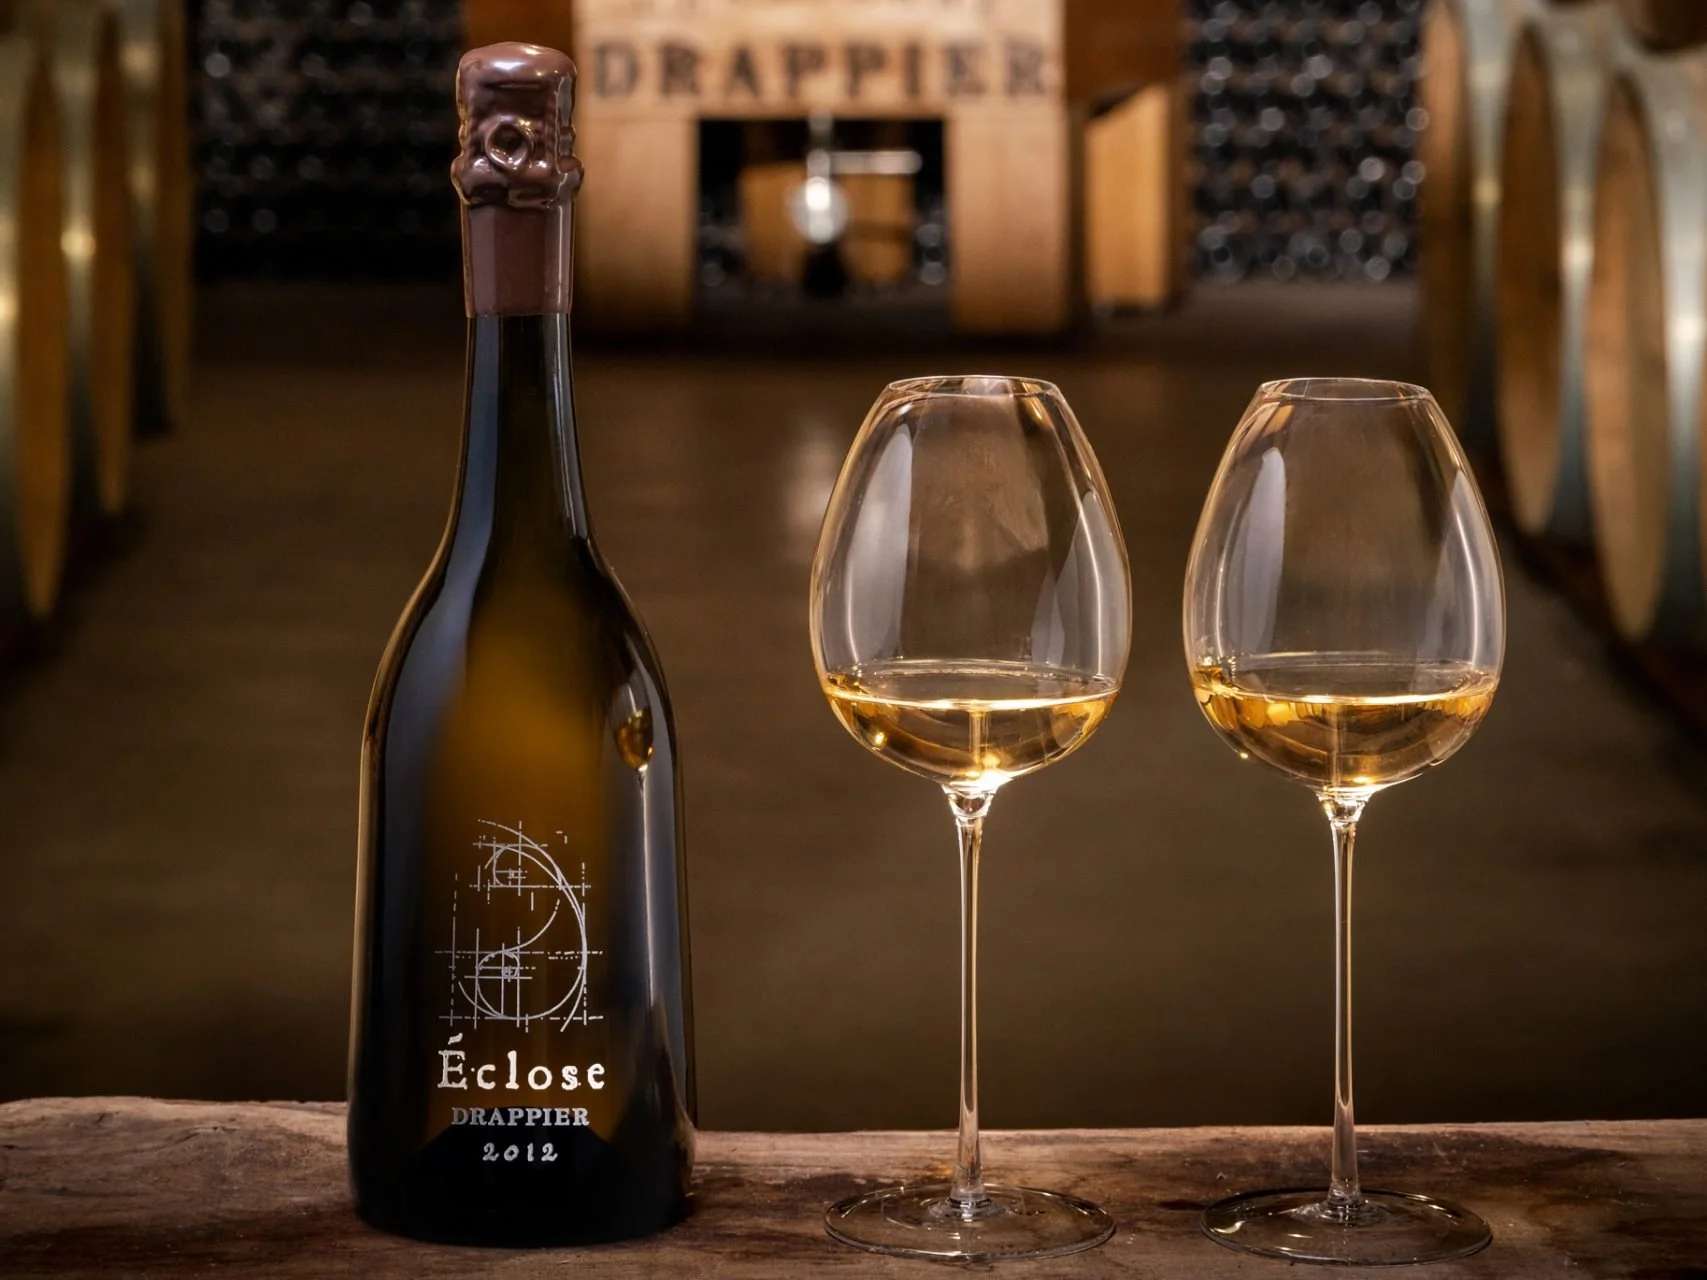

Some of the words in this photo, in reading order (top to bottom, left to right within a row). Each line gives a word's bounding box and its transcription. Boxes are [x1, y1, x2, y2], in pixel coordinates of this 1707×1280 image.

[593, 39, 1053, 100] DRAPPIER
[437, 1032, 605, 1090] Éclose
[451, 1107, 590, 1126] DRAPPIER
[482, 1142, 558, 1162] 2012
